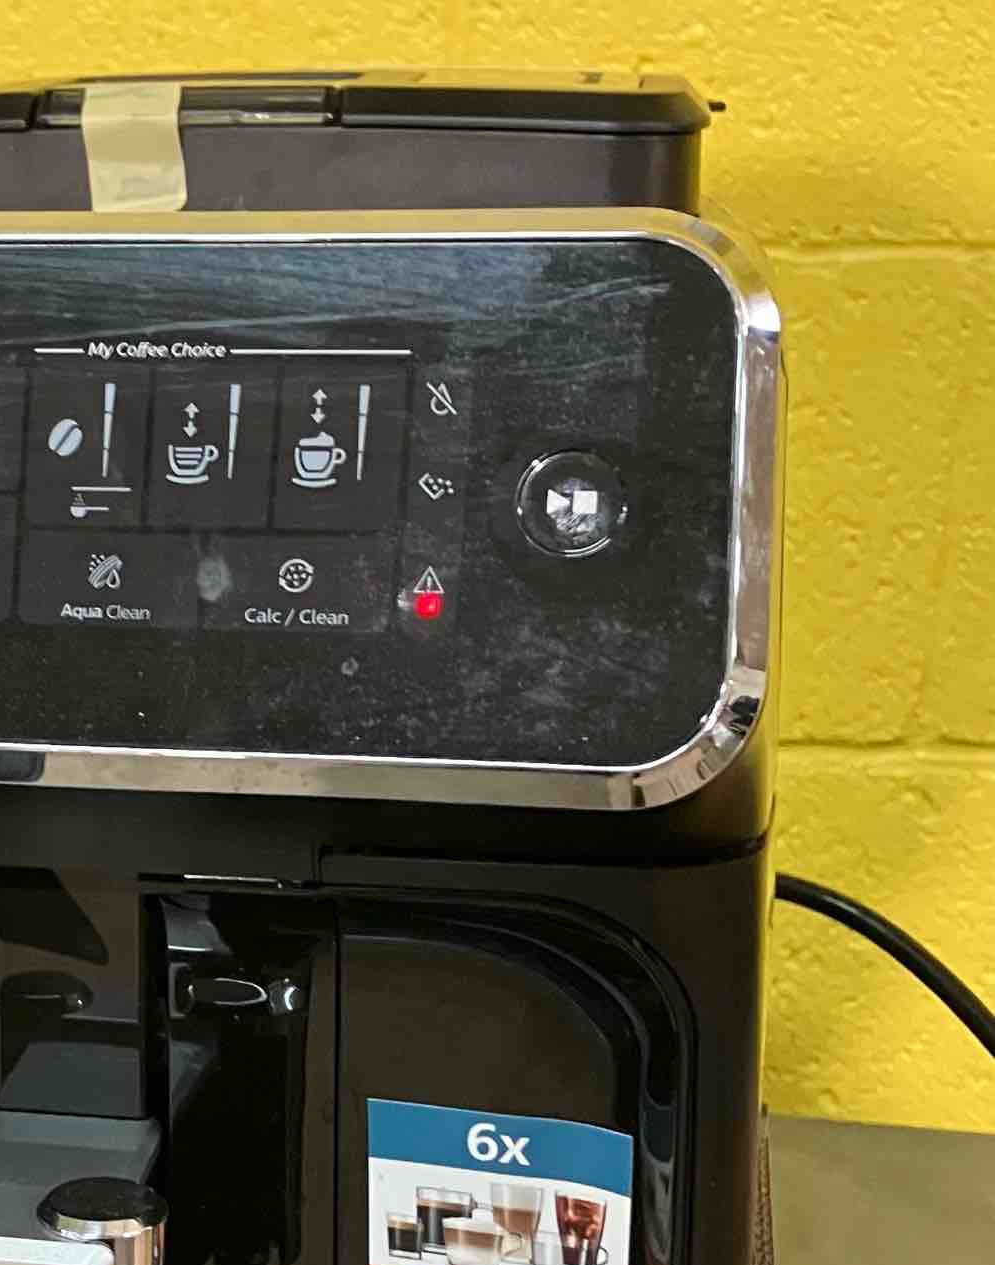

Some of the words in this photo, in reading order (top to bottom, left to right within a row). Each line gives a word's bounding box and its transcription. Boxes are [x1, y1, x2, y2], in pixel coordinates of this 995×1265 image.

[87, 342, 113, 360] My
[116, 342, 168, 358] Coffee
[170, 342, 226, 358] Choice
[60, 603, 103, 623] Aqua
[106, 605, 150, 621] Clean
[244, 608, 282, 624] Calc
[299, 609, 349, 626] Clean
[466, 1122, 530, 1166] 6x
